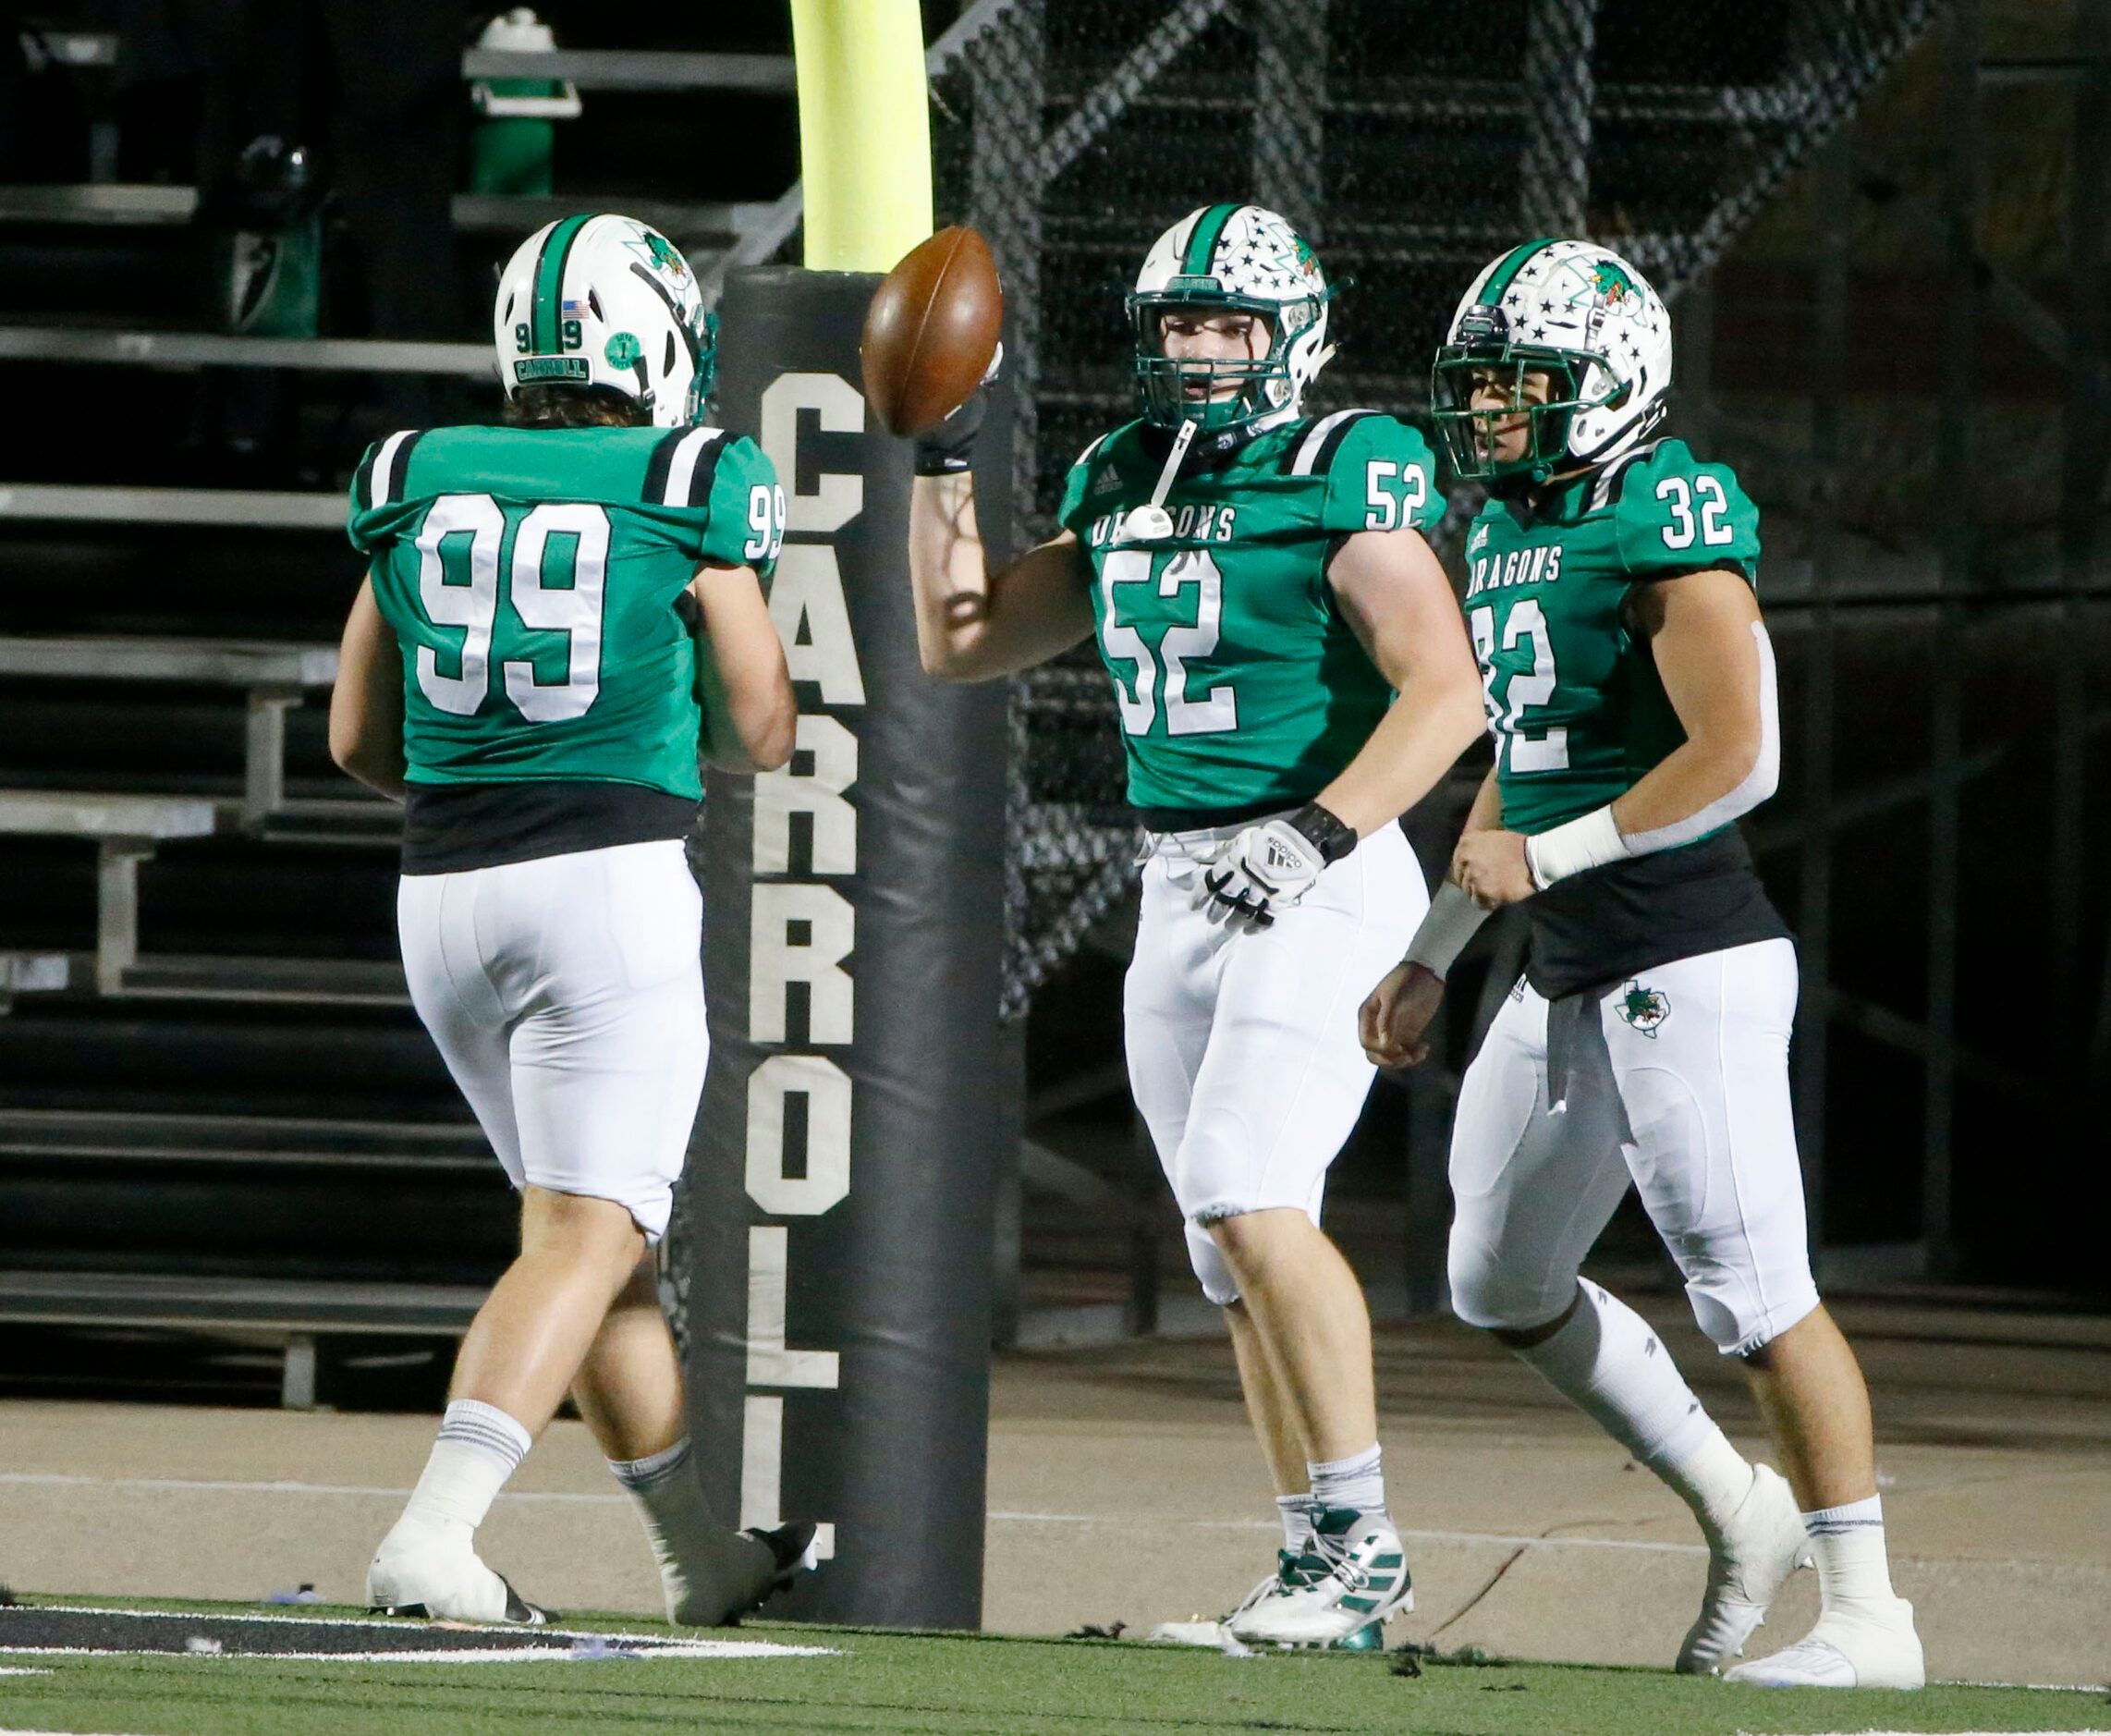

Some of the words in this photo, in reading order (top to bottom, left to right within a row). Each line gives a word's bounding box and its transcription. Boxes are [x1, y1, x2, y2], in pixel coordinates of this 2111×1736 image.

[744, 483, 787, 559] 99
[1365, 460, 1426, 530] 52
[1655, 476, 1733, 549] 32
[416, 494, 611, 722] 99
[1103, 550, 1238, 736] 52
[740, 373, 866, 1559] CARROLL
